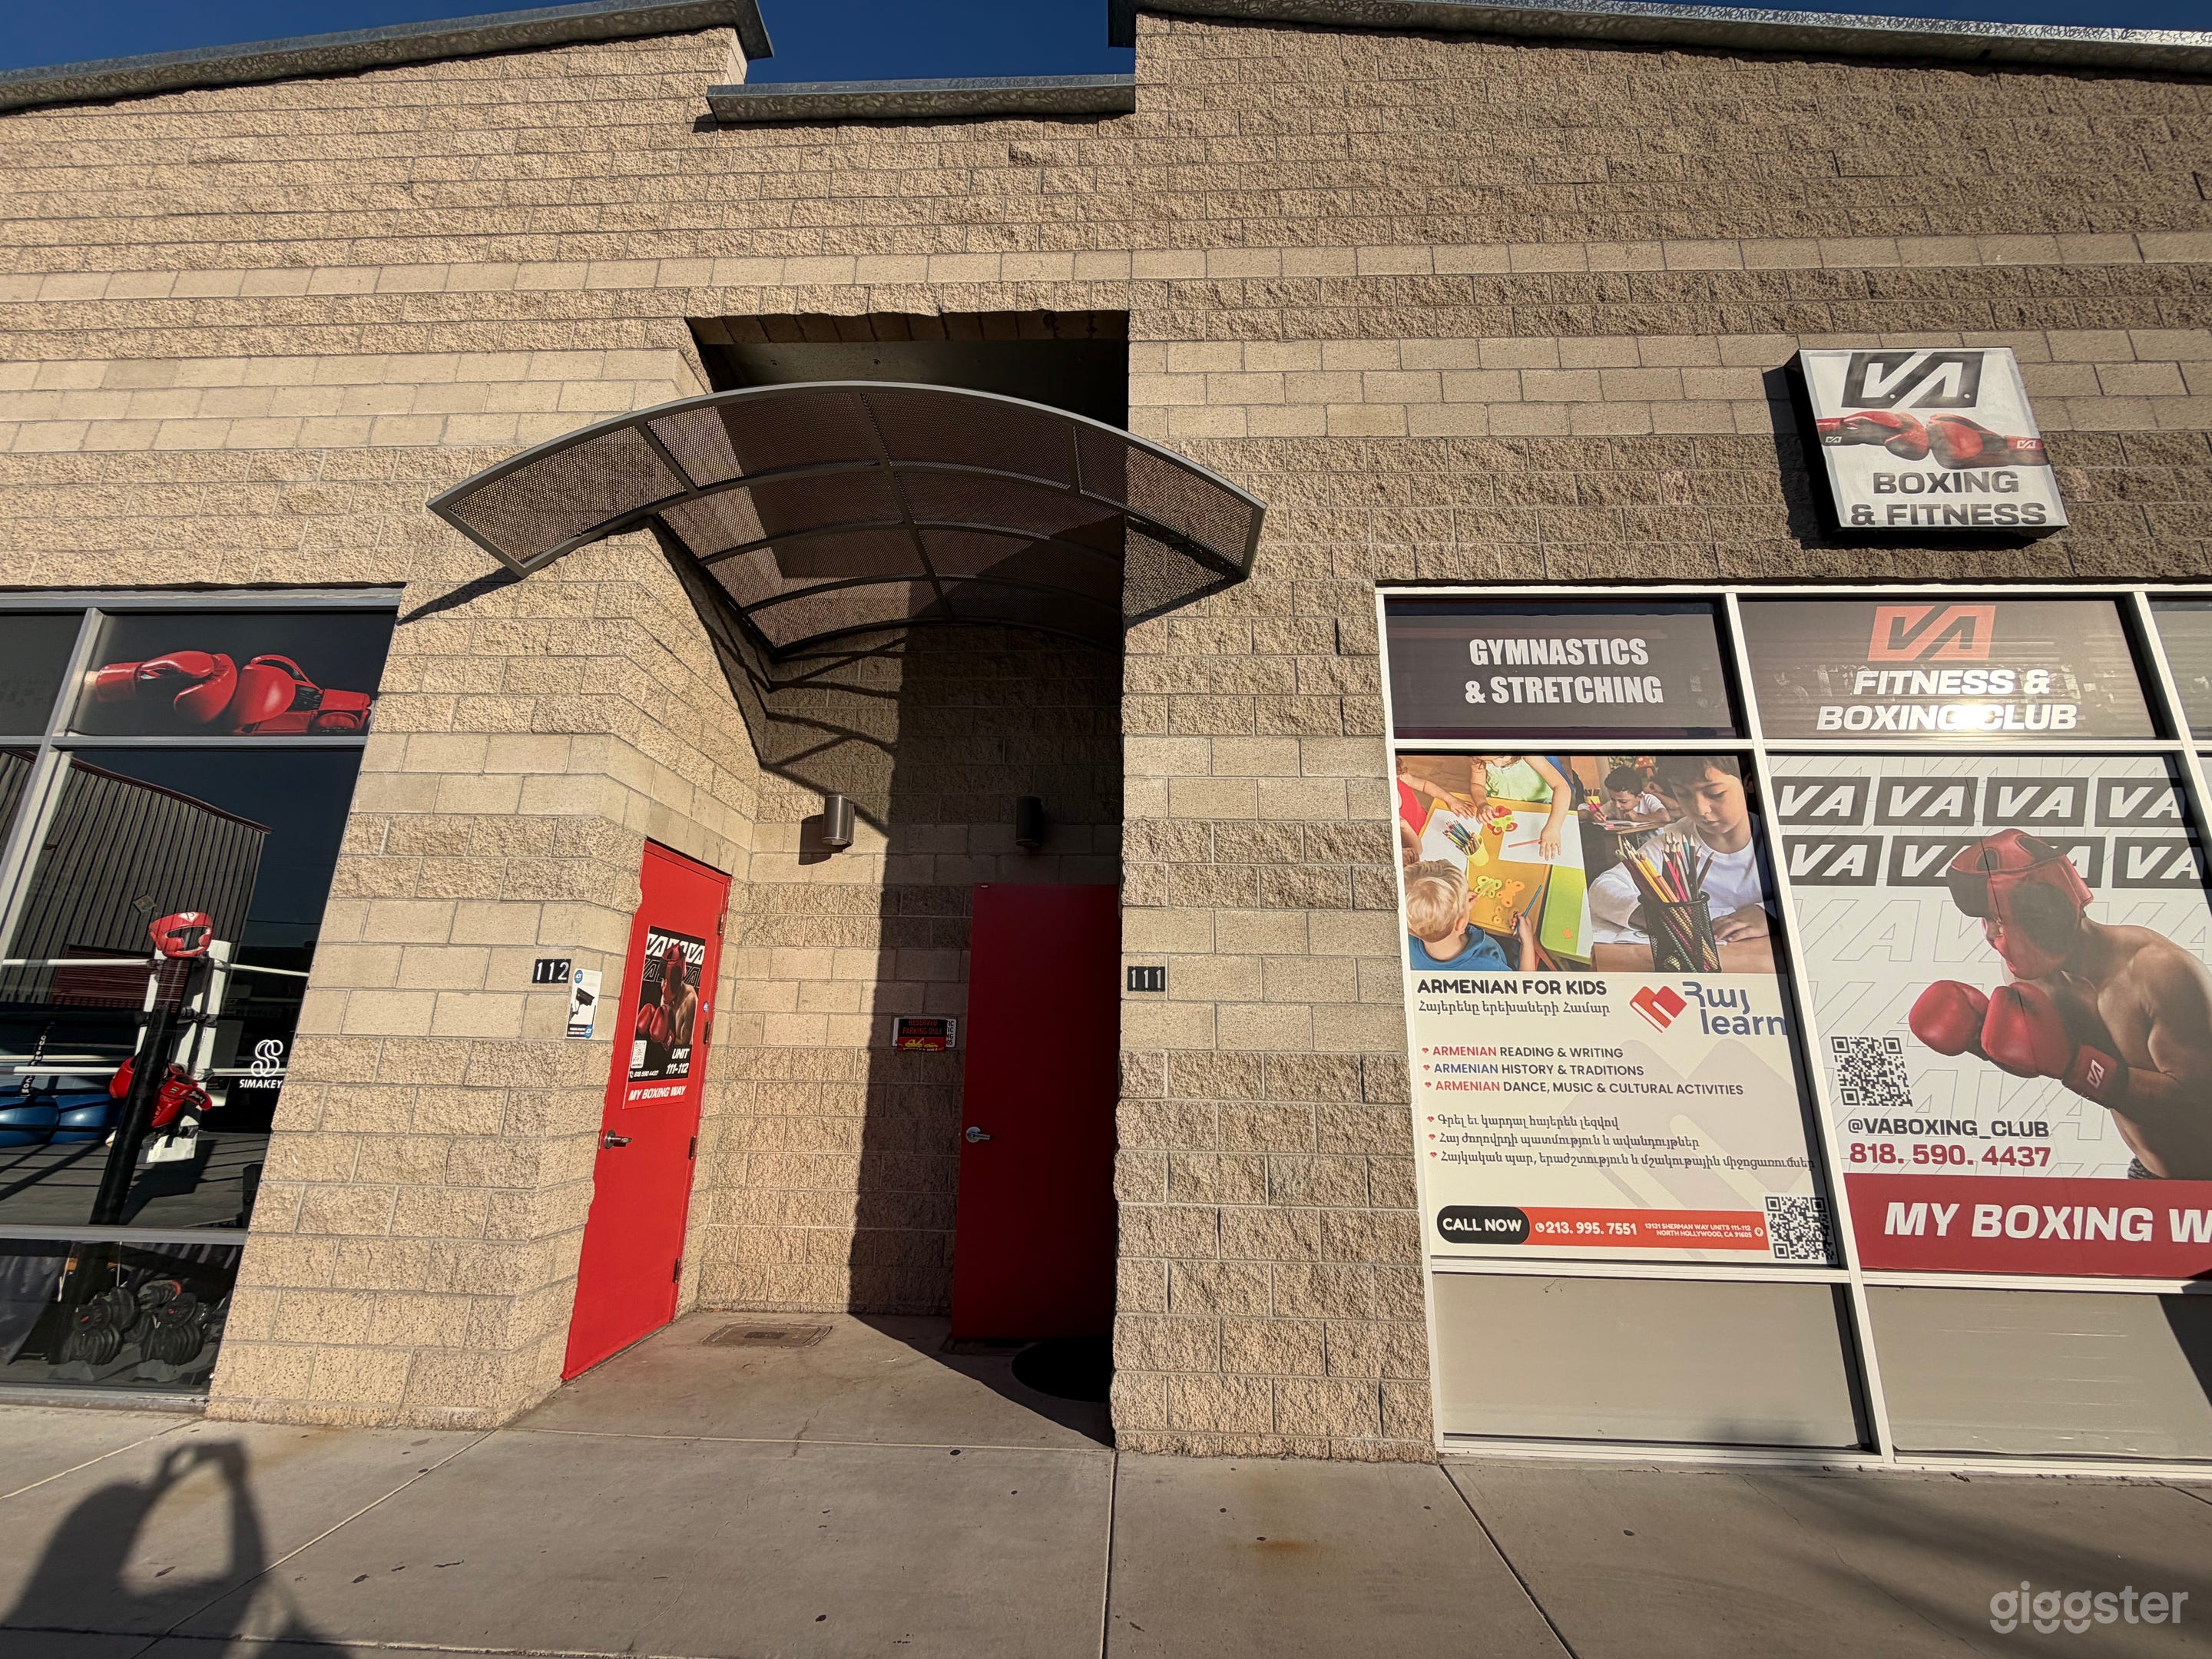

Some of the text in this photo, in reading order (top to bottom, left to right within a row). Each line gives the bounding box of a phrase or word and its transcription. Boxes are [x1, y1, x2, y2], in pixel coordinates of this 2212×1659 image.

[1841, 351, 1985, 409] VA
[1873, 471, 2019, 495] BOXING
[1851, 502, 2048, 526] & FITNESS
[1867, 604, 1996, 661] VA
[1469, 638, 1650, 666] GYMNASTICS
[1465, 676, 1664, 704] & STRETCHING
[1853, 668, 2051, 696] FITNESS &
[1975, 705, 2078, 730] CLUB
[1778, 784, 1856, 817] VA
[1888, 785, 1965, 818] VA
[1996, 786, 2075, 818] VA
[2108, 786, 2185, 820] VA
[1789, 844, 1869, 877] VA
[2126, 846, 2205, 879] VA
[536, 961, 569, 981] 112
[1131, 969, 1161, 988] 111
[1417, 978, 1608, 995] ARMENIAN FOR KIDS
[1700, 1008, 1789, 1036] learn
[672, 1048, 690, 1059] UNIT
[1432, 1046, 1624, 1058] ARMENIAN READING & WRITING
[666, 1063, 690, 1075] 111-112
[1434, 1063, 1644, 1076] ARMENIAN HISTORY & TRADITIONS
[239, 1078, 283, 1089] SIMAKEY
[628, 1085, 687, 1101] MY BOXING WAY
[1435, 1081, 1743, 1095] ARMENIAN DANCE, MUSIC & CULTURAL ACTIVITIES
[1848, 1118, 2050, 1139] @VABOXING_CLUB
[1849, 1143, 2051, 1167] 818. 590. 4437
[1442, 1217, 1522, 1233] CALL NOW
[1546, 1221, 1637, 1236] 213. 995. 7551
[1884, 1202, 1960, 1237] MY
[1971, 1204, 2154, 1243] BOXING
